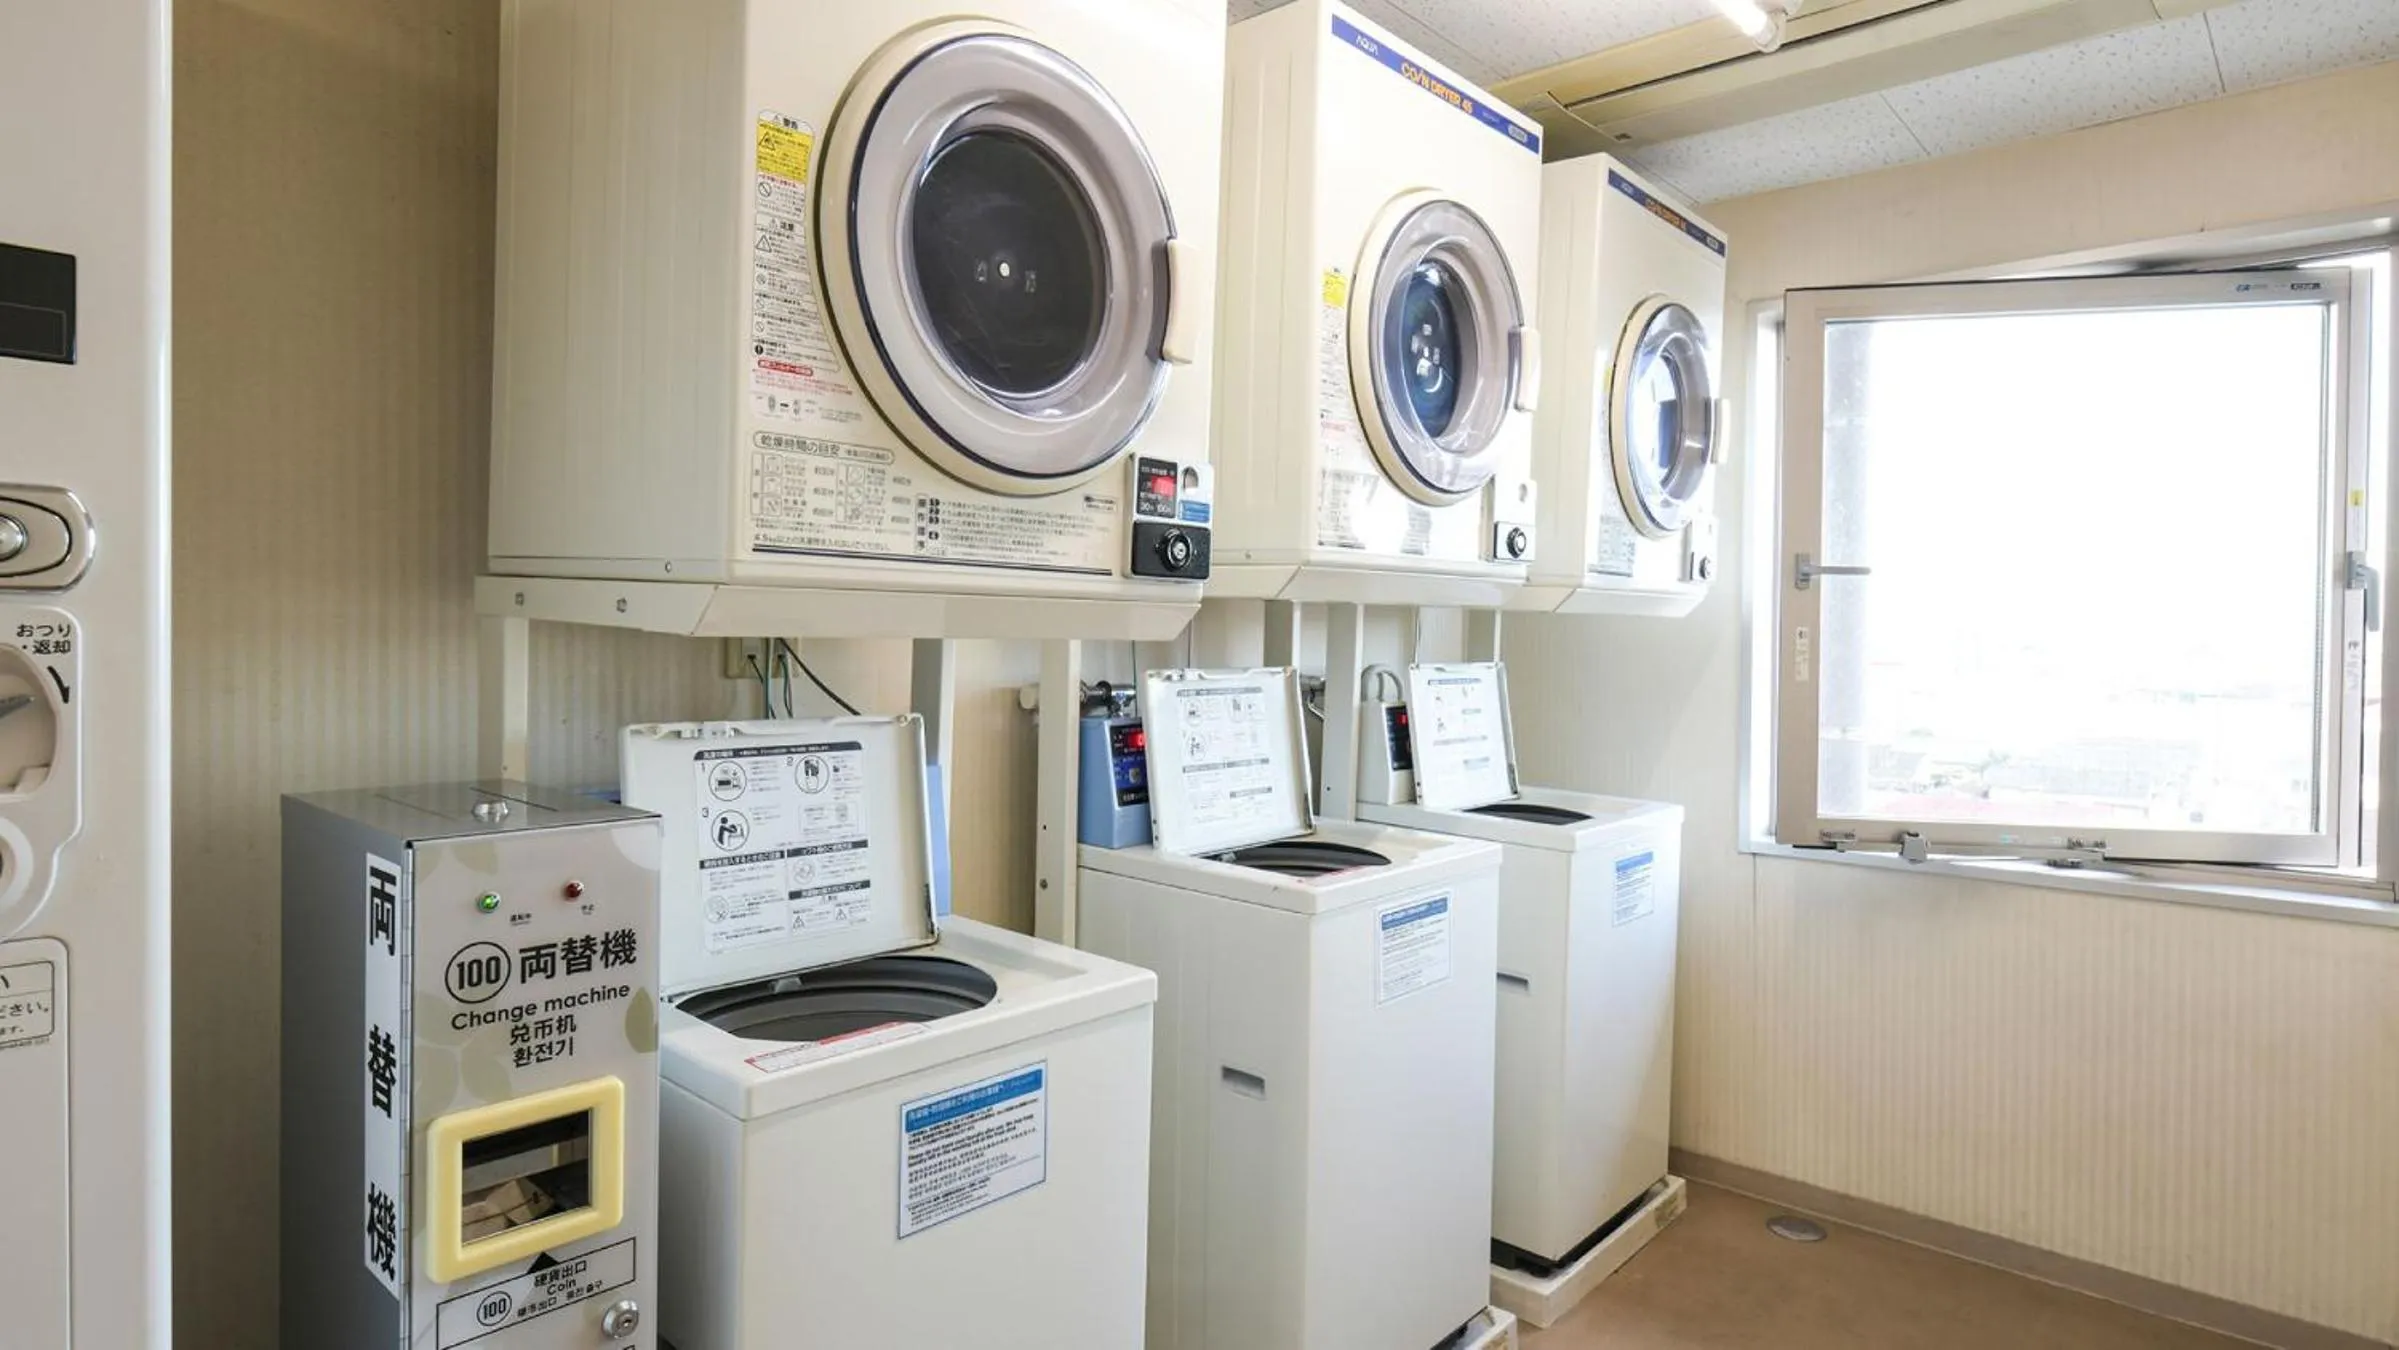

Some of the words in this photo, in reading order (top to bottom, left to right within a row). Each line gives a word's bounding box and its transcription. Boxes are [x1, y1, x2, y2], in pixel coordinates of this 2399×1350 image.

[16, 623, 71, 638] おつり
[456, 956, 501, 991] 100
[518, 928, 637, 984] 両替機
[452, 1002, 538, 1030] Change
[544, 984, 631, 1013] machine
[512, 1036, 574, 1068] 환전기
[366, 865, 397, 1281] 両替機
[547, 1279, 577, 1296] Coin
[482, 1298, 507, 1321] 100
